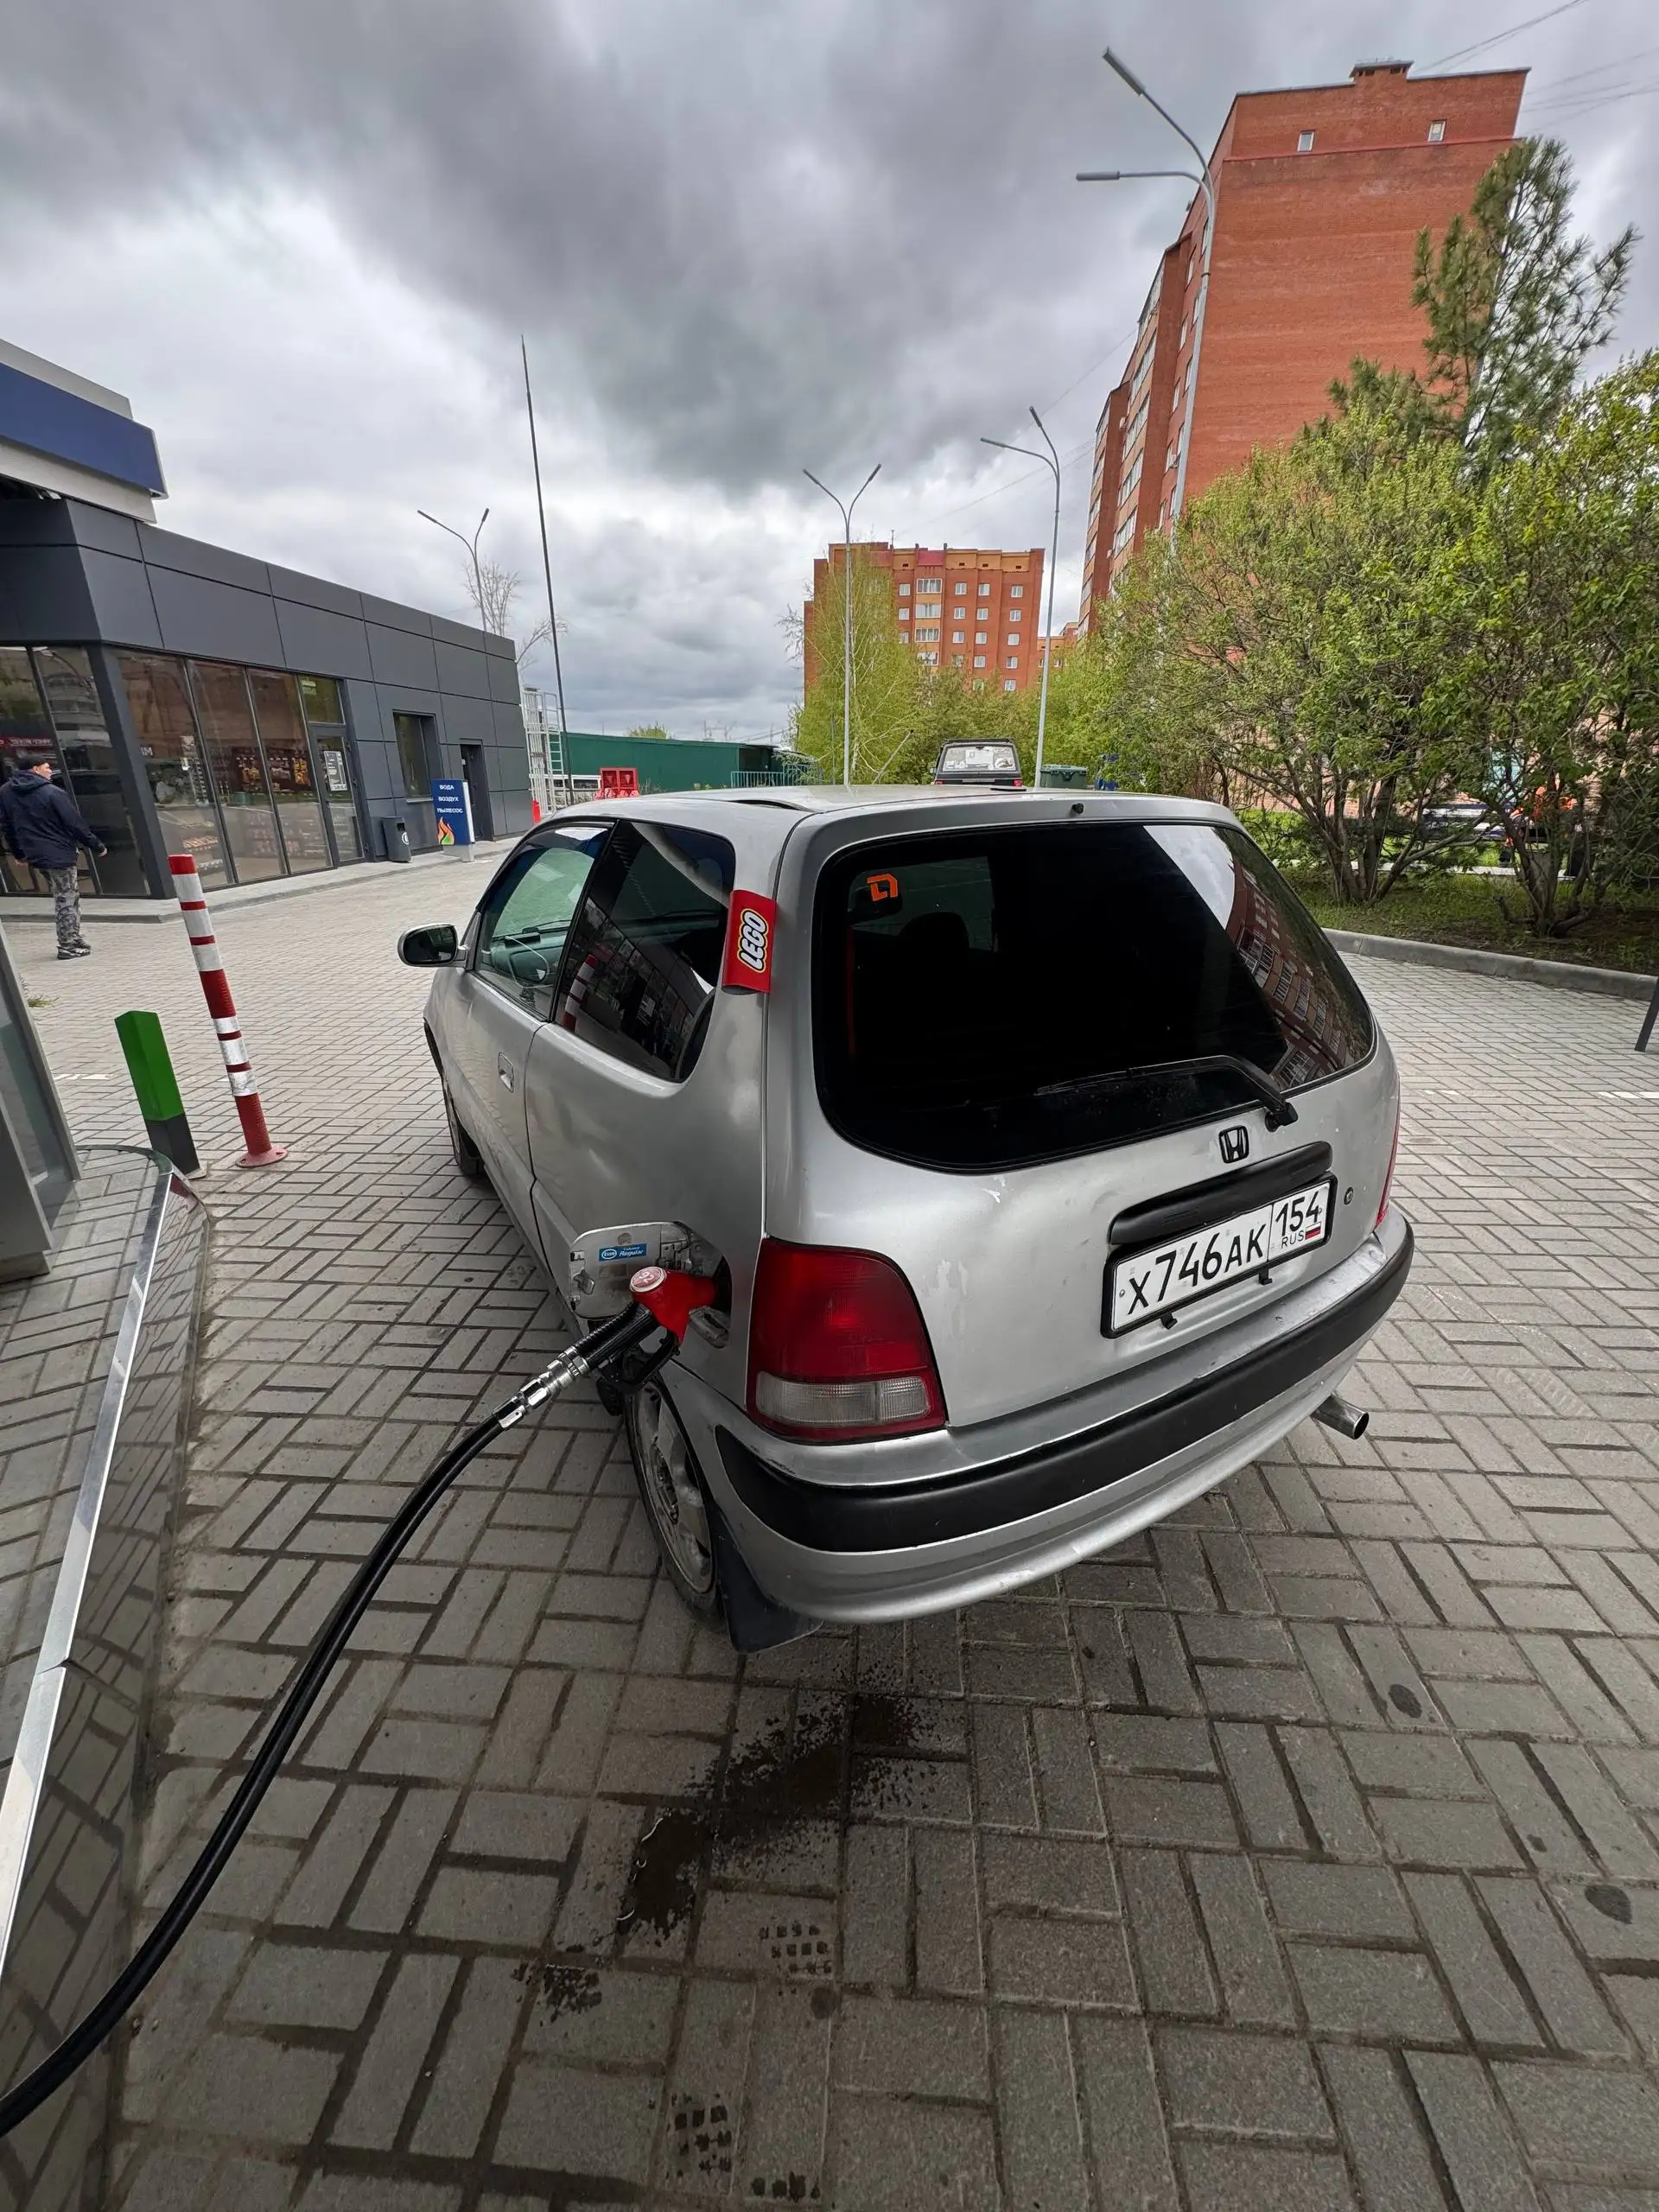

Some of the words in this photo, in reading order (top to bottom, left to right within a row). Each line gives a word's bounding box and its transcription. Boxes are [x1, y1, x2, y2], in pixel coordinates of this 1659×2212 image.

[739, 910, 767, 971] LEGO
[1274, 1192, 1321, 1236] 154
[1281, 1230, 1305, 1249] RUS
